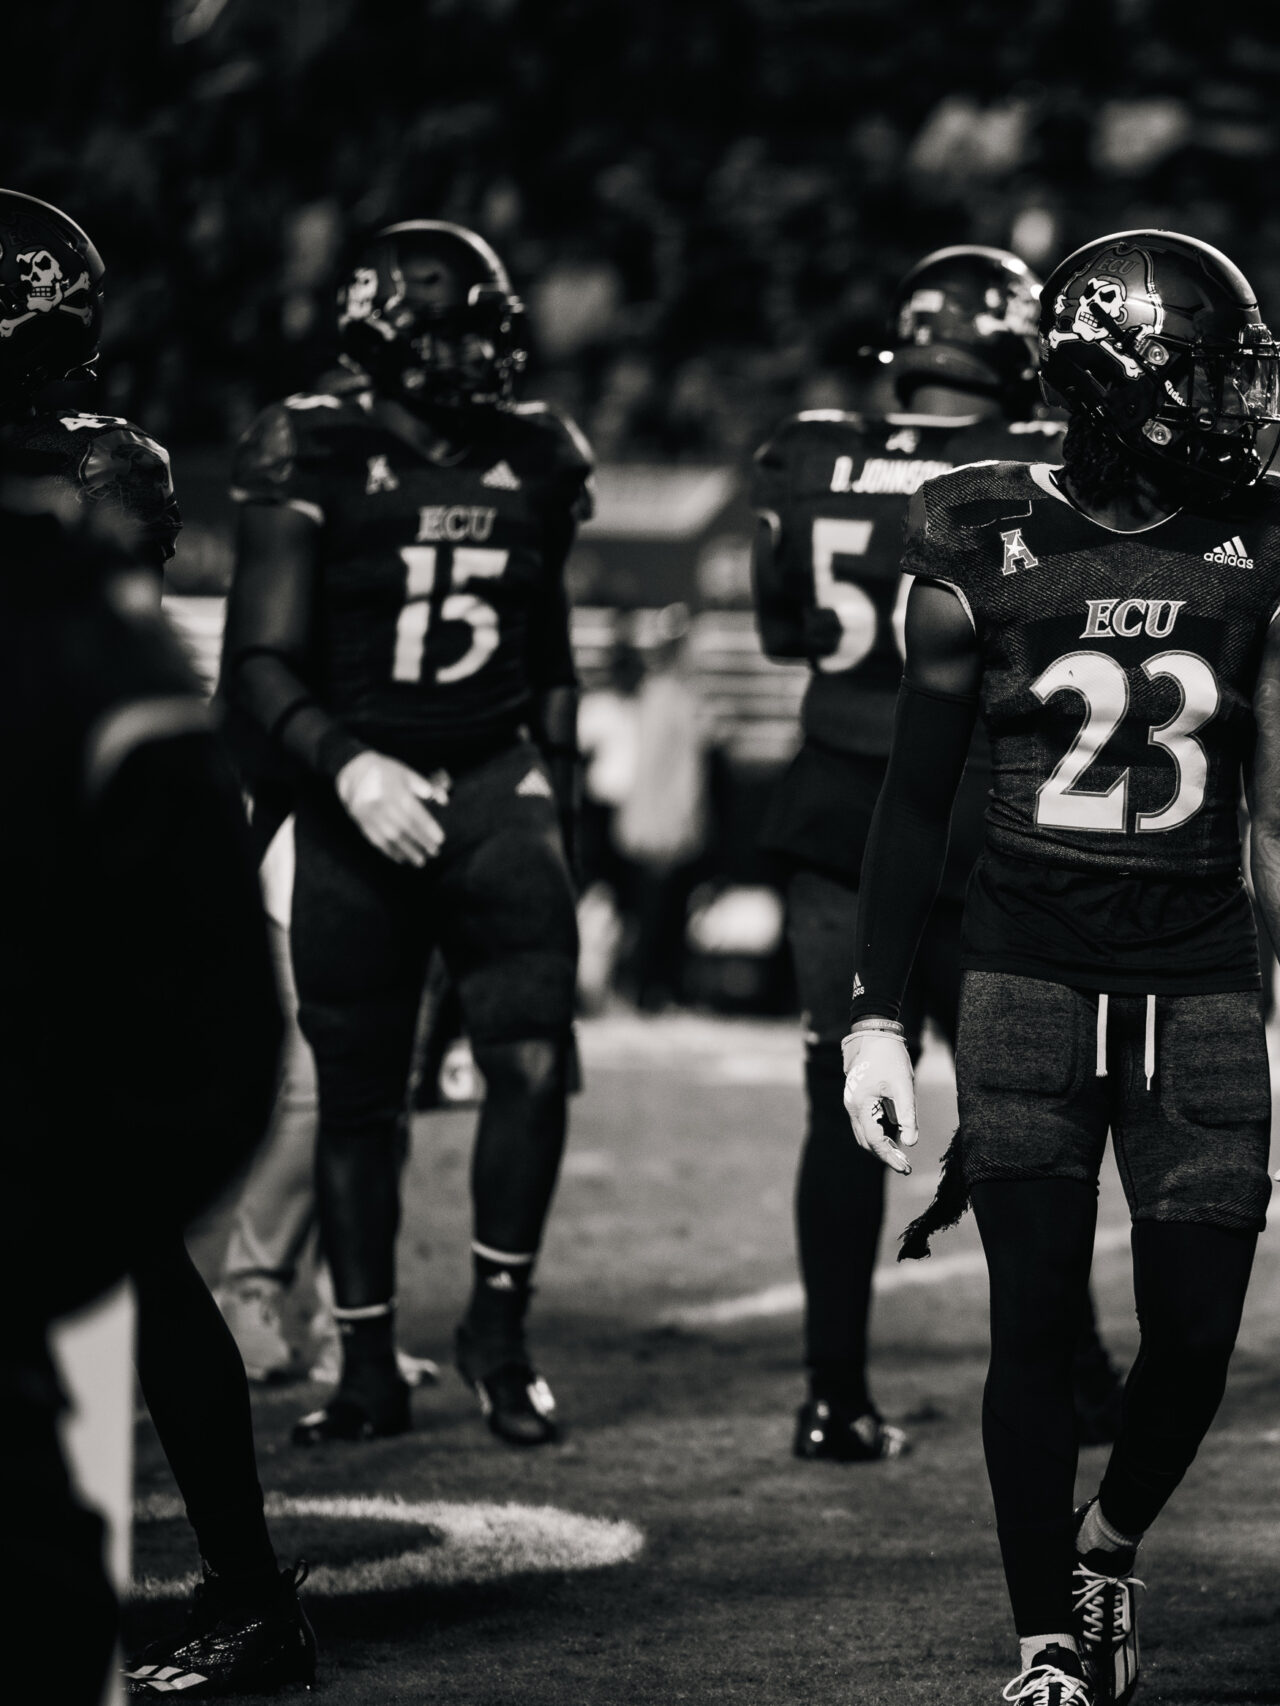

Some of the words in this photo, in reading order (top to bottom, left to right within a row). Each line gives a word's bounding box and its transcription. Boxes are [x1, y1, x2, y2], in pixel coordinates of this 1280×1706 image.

[1097, 258, 1141, 275] ECU
[415, 504, 498, 543] ECU
[1203, 551, 1254, 570] adidas
[391, 545, 510, 684] 15
[1078, 598, 1188, 640] ECU
[1028, 650, 1222, 834] 23
